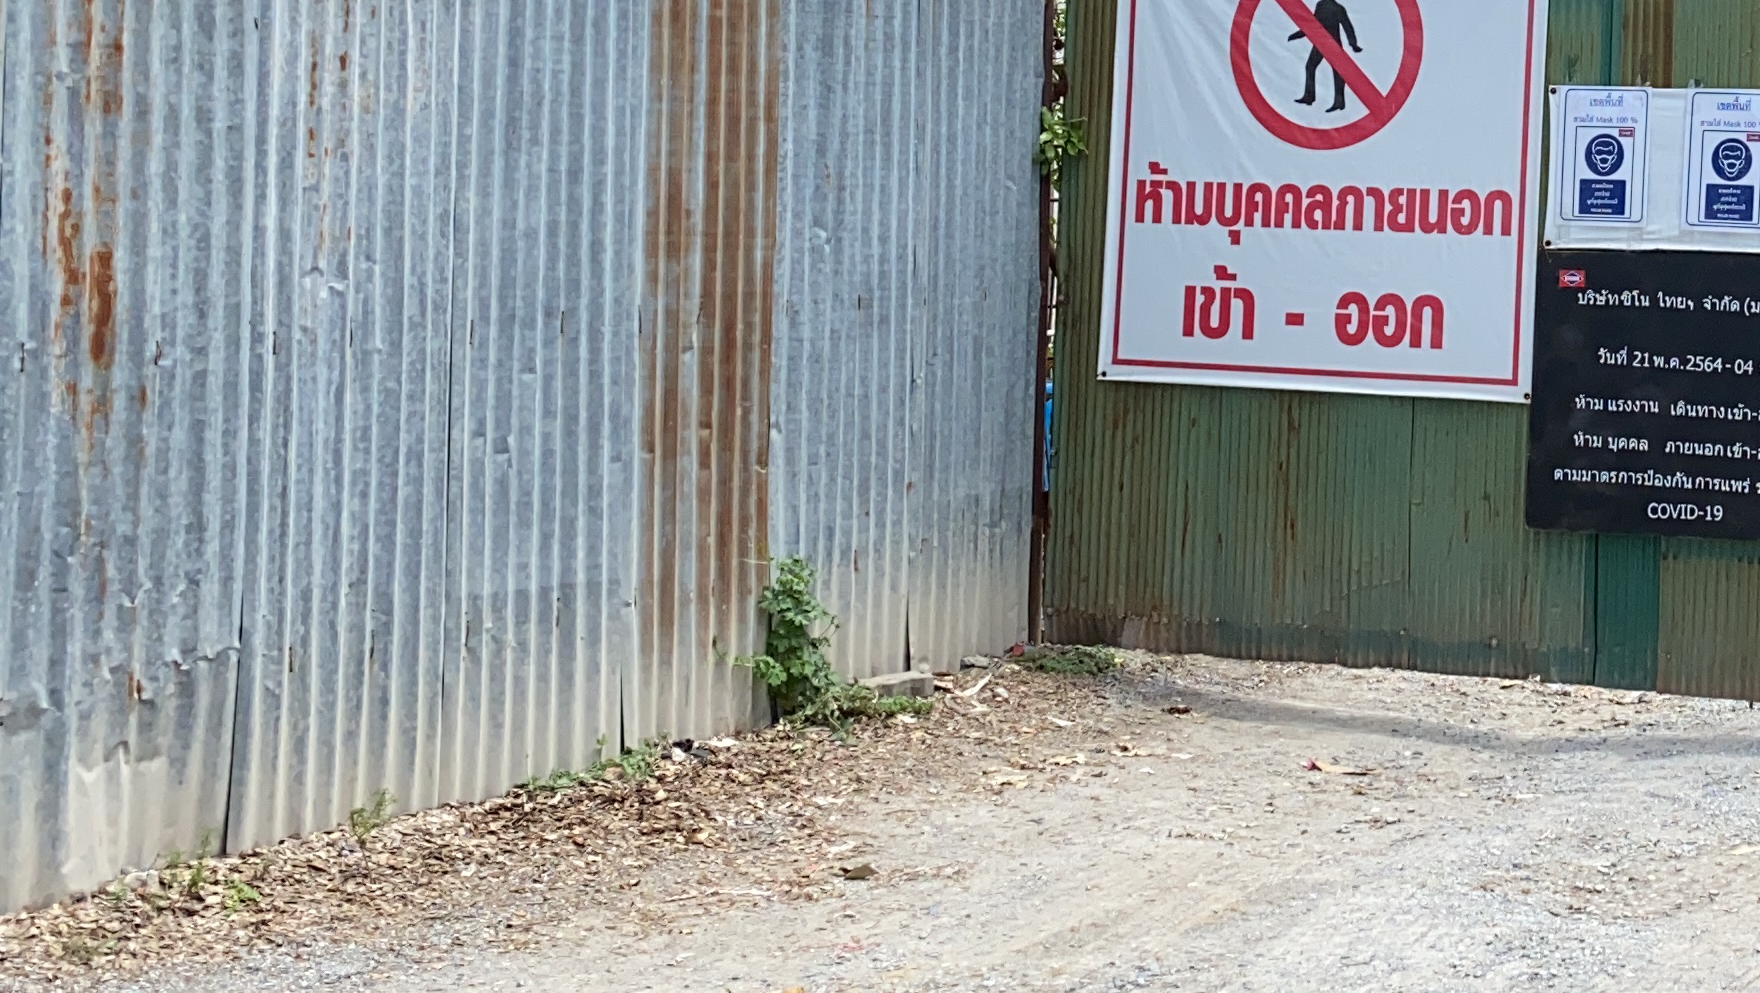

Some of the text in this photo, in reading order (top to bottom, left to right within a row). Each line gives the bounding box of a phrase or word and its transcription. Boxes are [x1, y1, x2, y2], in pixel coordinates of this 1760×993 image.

[1134, 161, 1513, 246] ห้ามบุคคลภายนอก
[1181, 264, 1256, 341] เข้า
[1333, 290, 1445, 350] ออก
[1597, 346, 1628, 366] วันที่
[1574, 393, 1603, 410] ห้าม
[1607, 398, 1659, 413] แรงงาน
[1573, 430, 1602, 448] ห้าม
[1607, 436, 1649, 452] บุคคล
[1647, 502, 1724, 522] COVID-19
